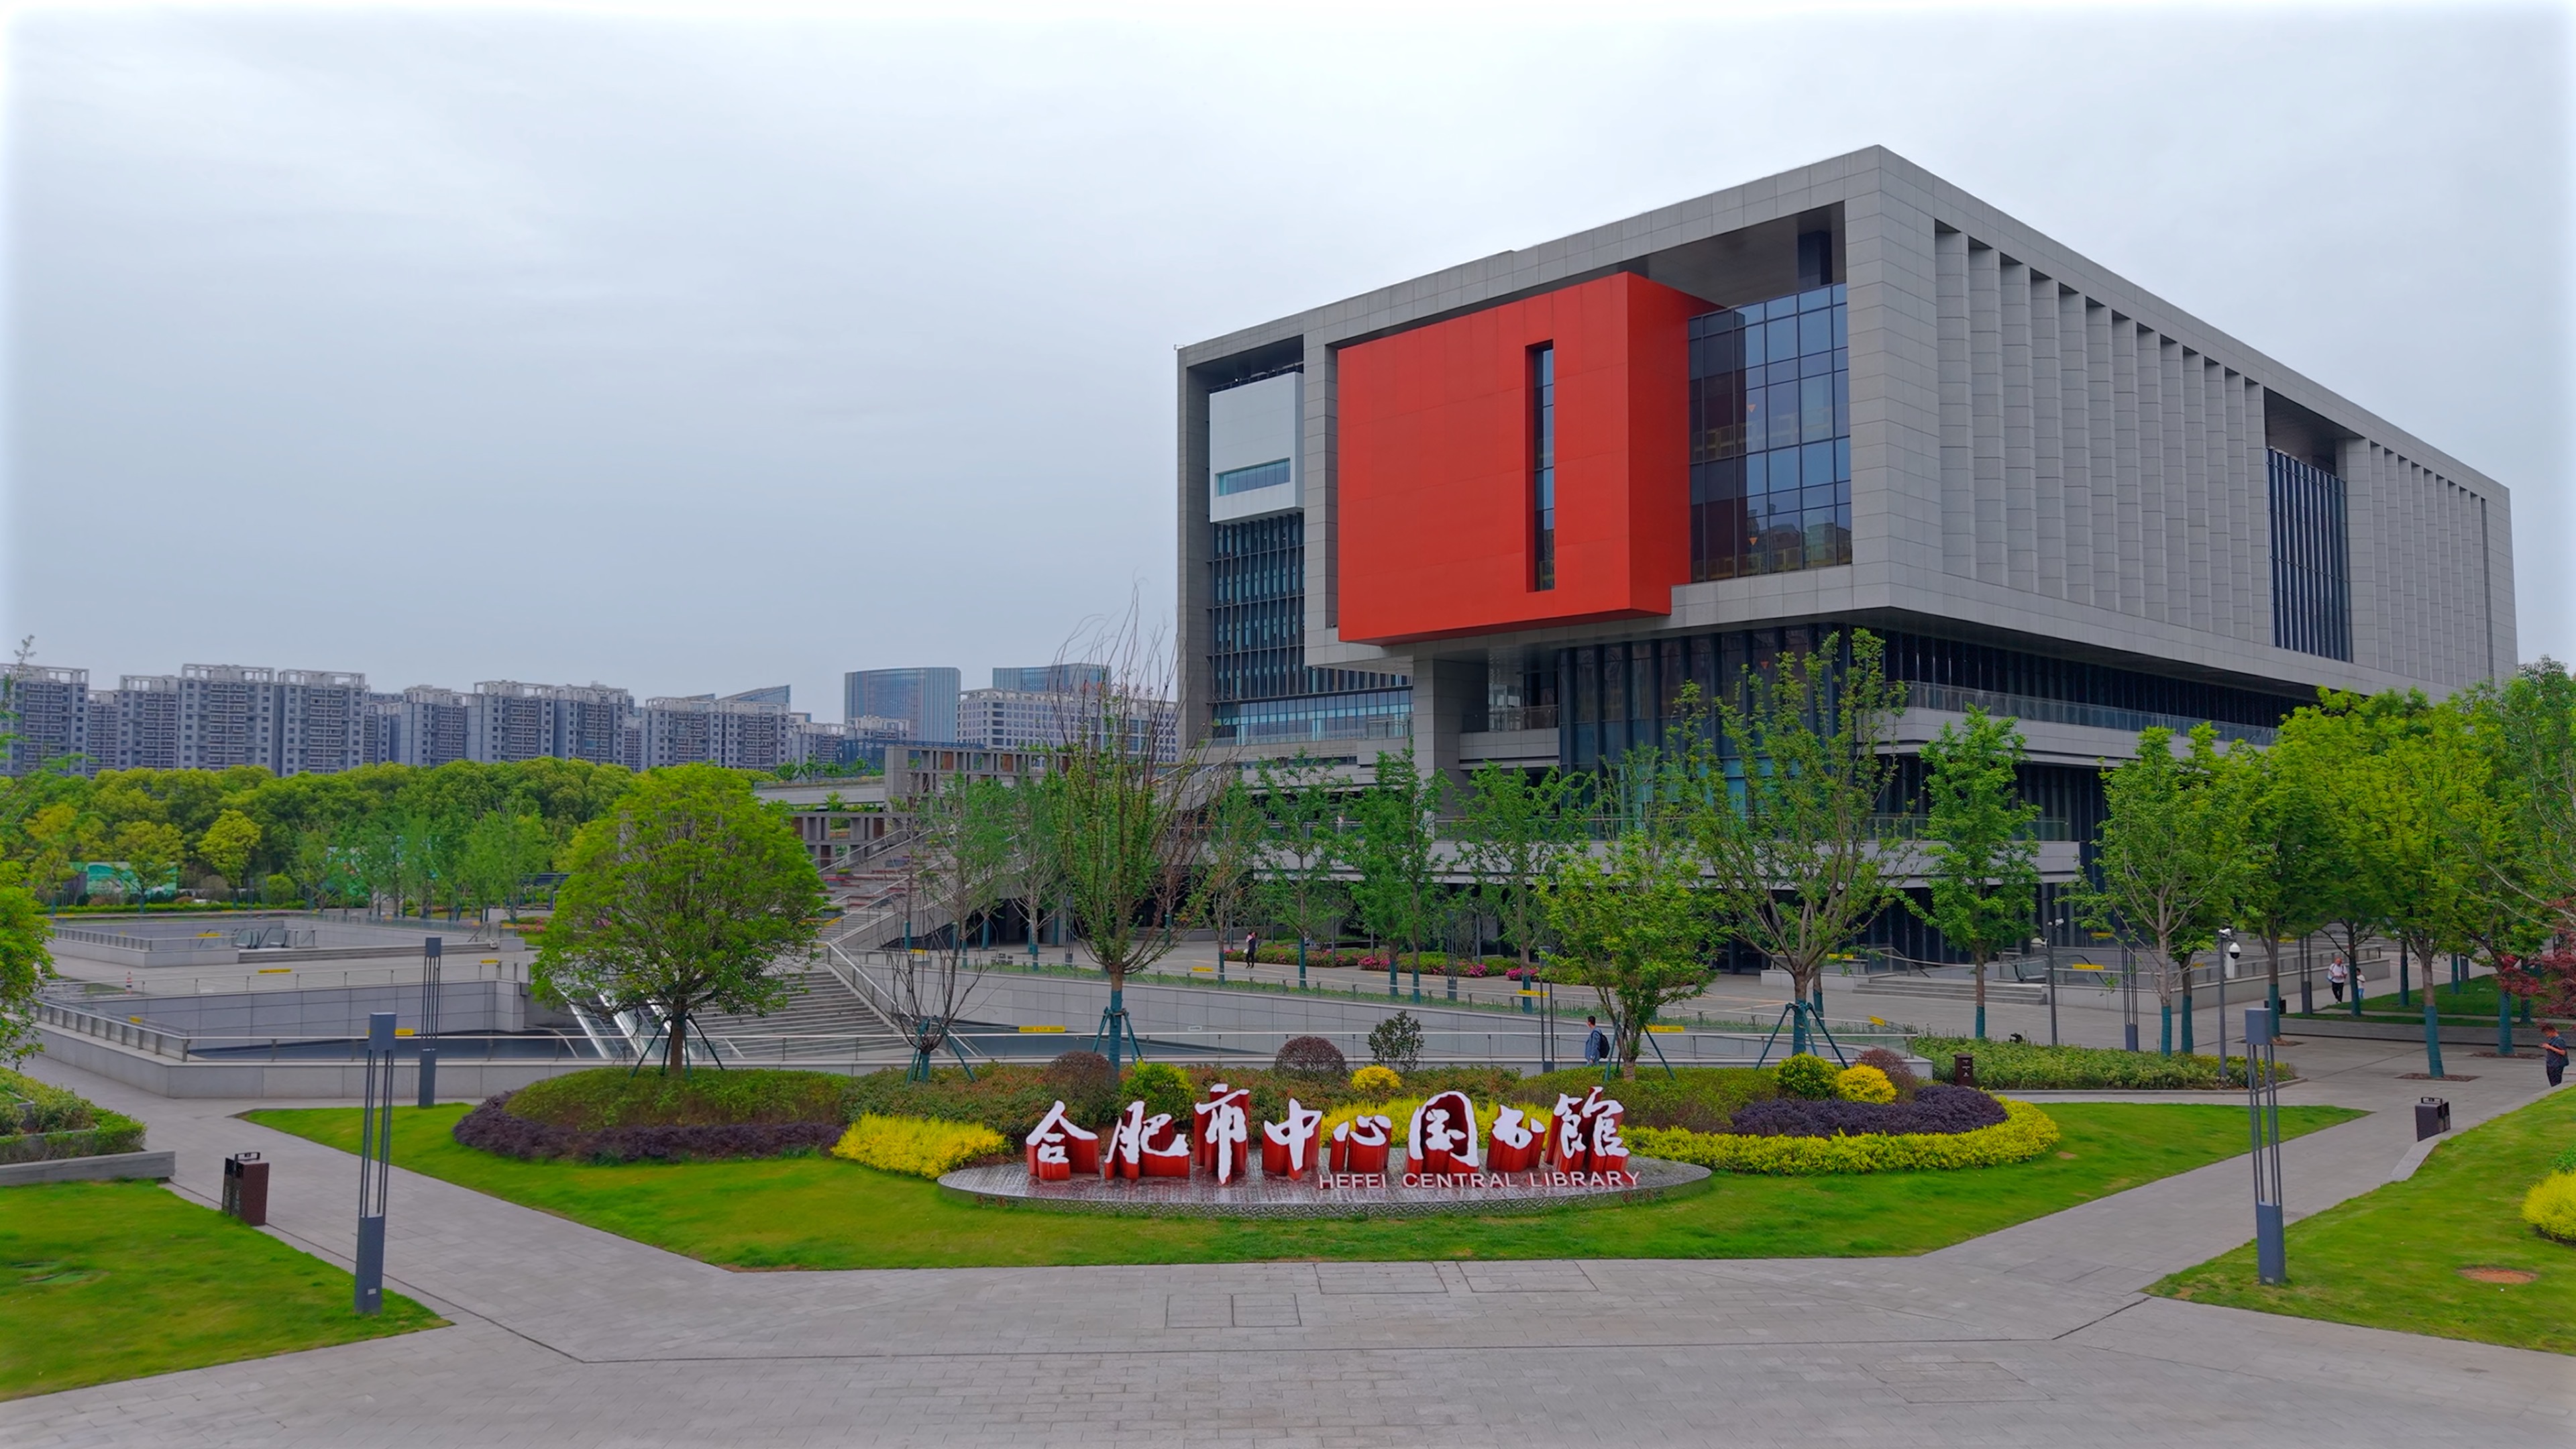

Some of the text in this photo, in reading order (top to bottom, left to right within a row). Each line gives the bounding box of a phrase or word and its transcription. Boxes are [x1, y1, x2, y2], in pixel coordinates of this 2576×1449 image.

[1319, 1171, 1640, 1189] HEFEI CENTRAL LIBRARY
